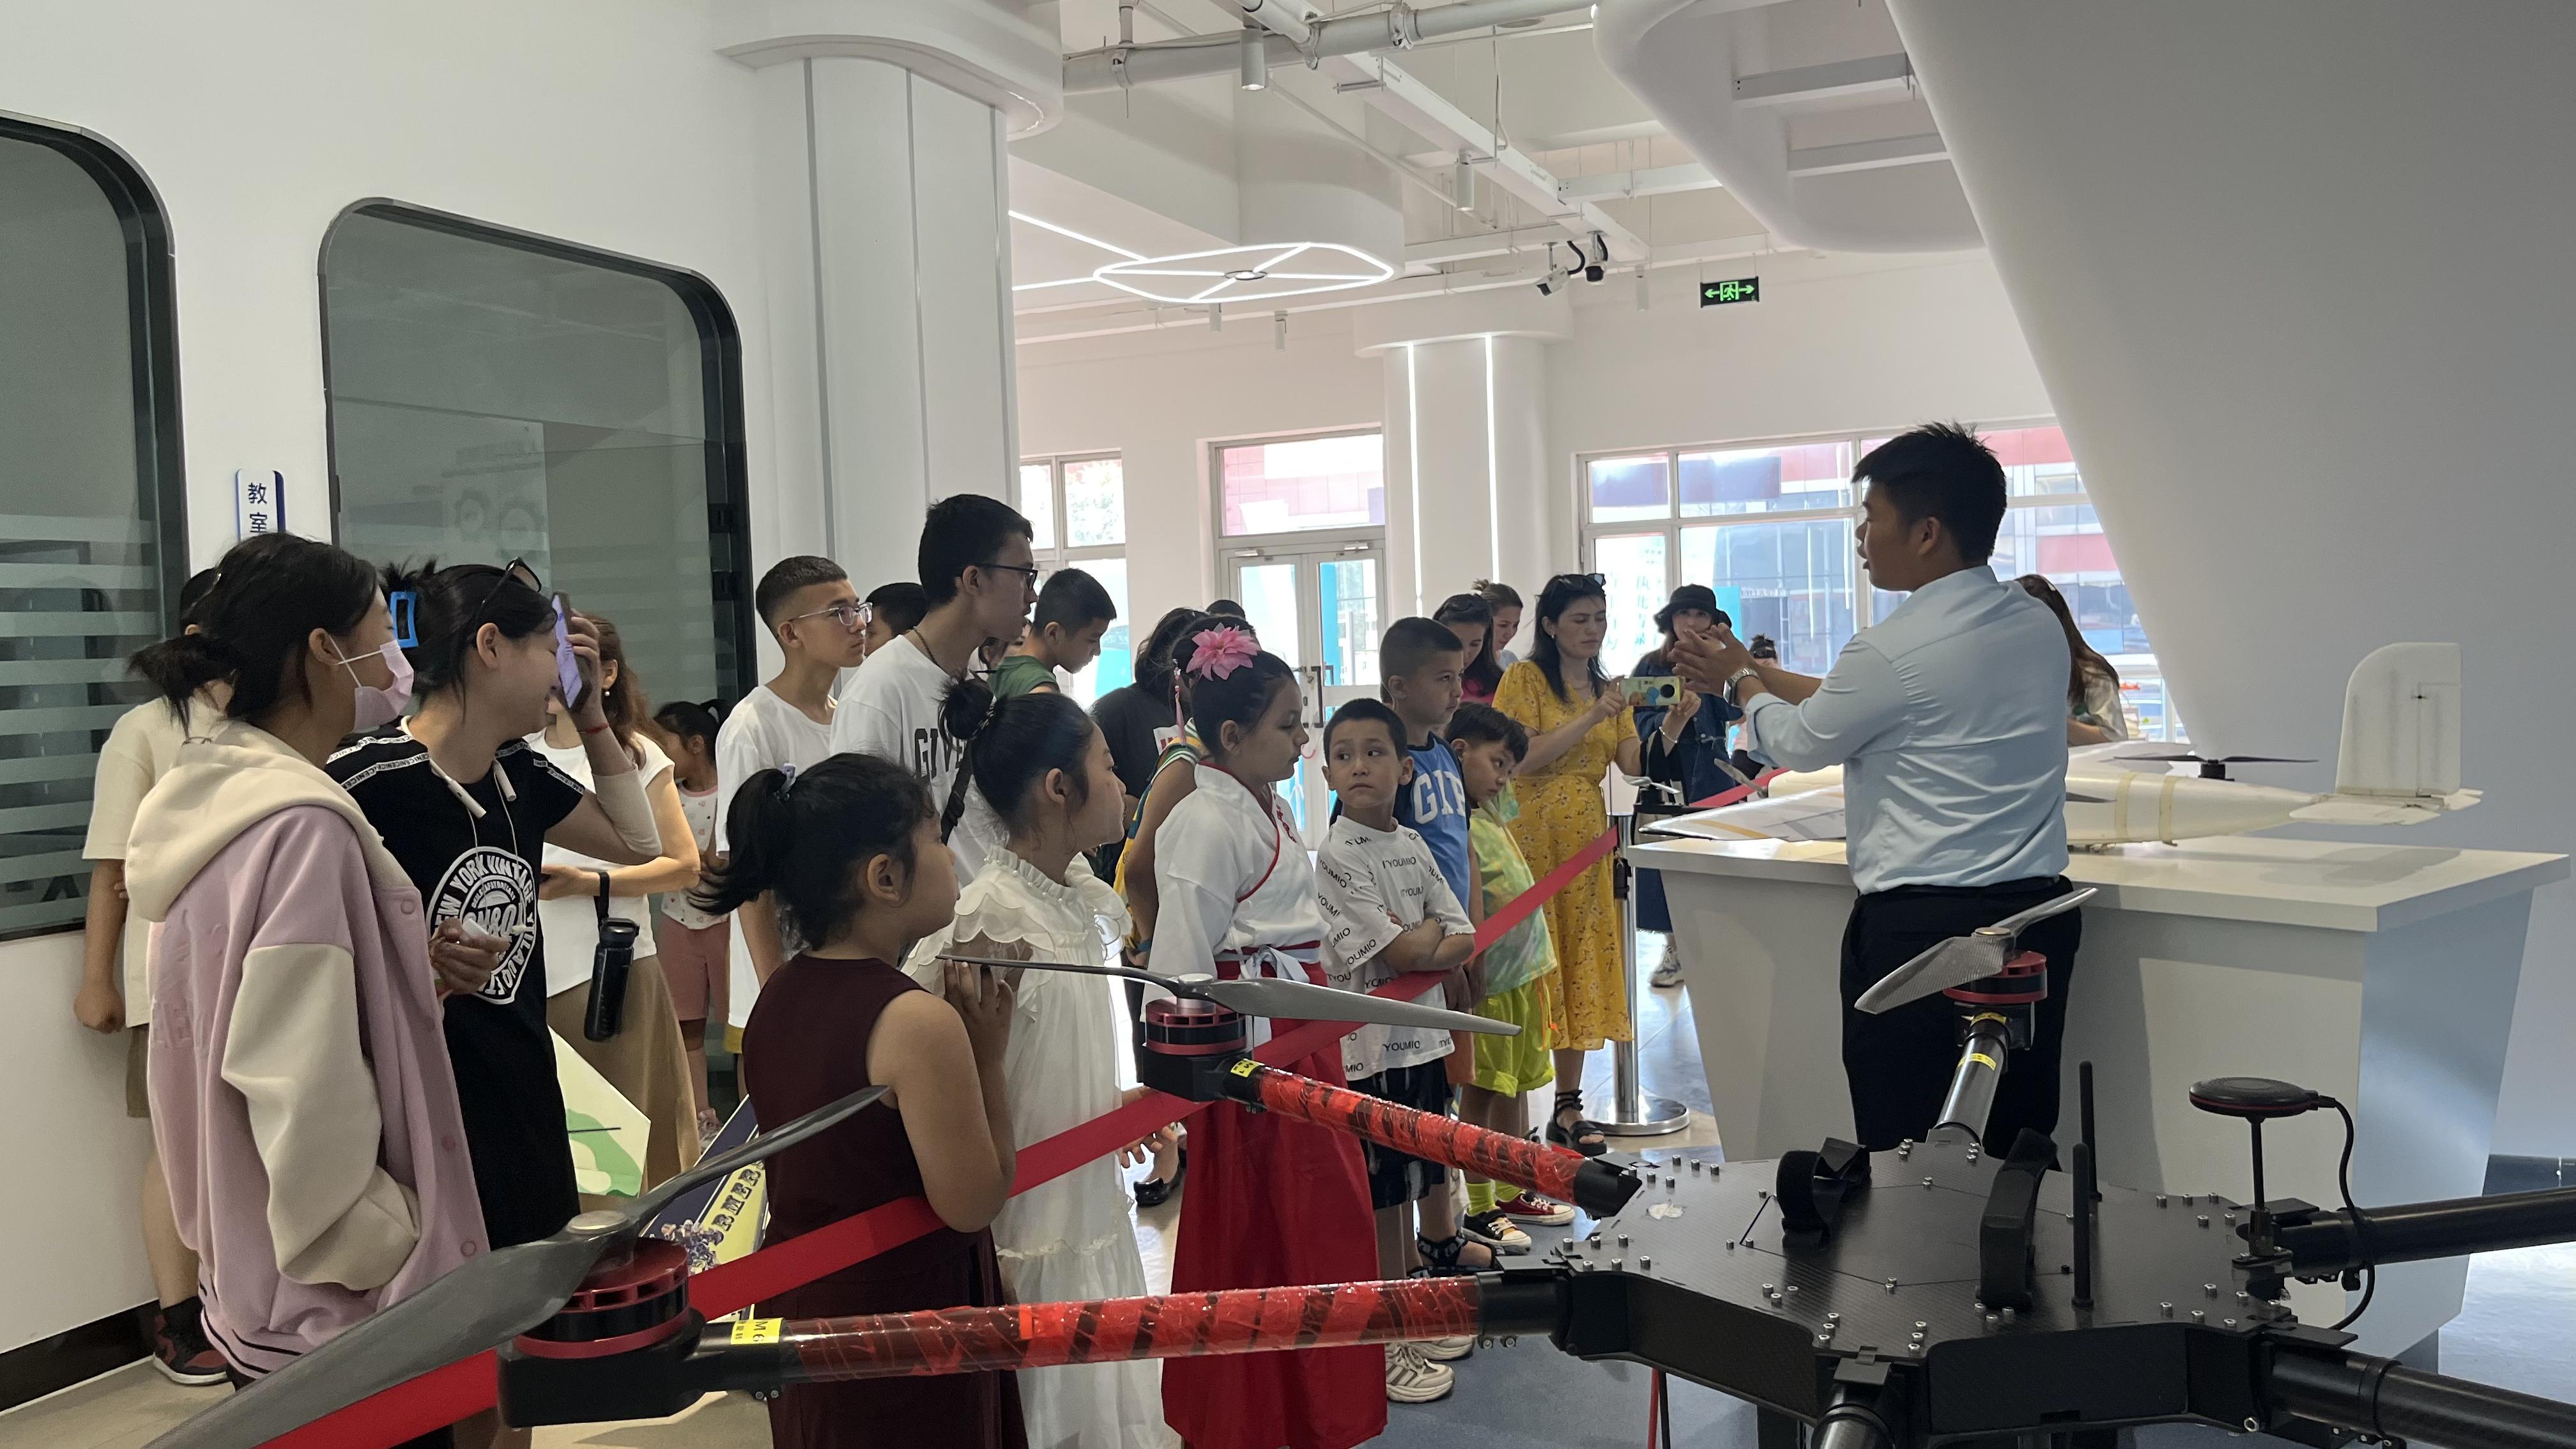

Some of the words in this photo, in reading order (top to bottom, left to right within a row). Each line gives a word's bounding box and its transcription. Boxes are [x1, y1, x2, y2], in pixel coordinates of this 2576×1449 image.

[248, 482, 267, 533] 教室
[450, 855, 489, 893] YORK
[487, 855, 533, 905] VINTAGE
[1346, 939, 1376, 965] OUMIO
[1383, 1040, 1420, 1052] YOUMIO
